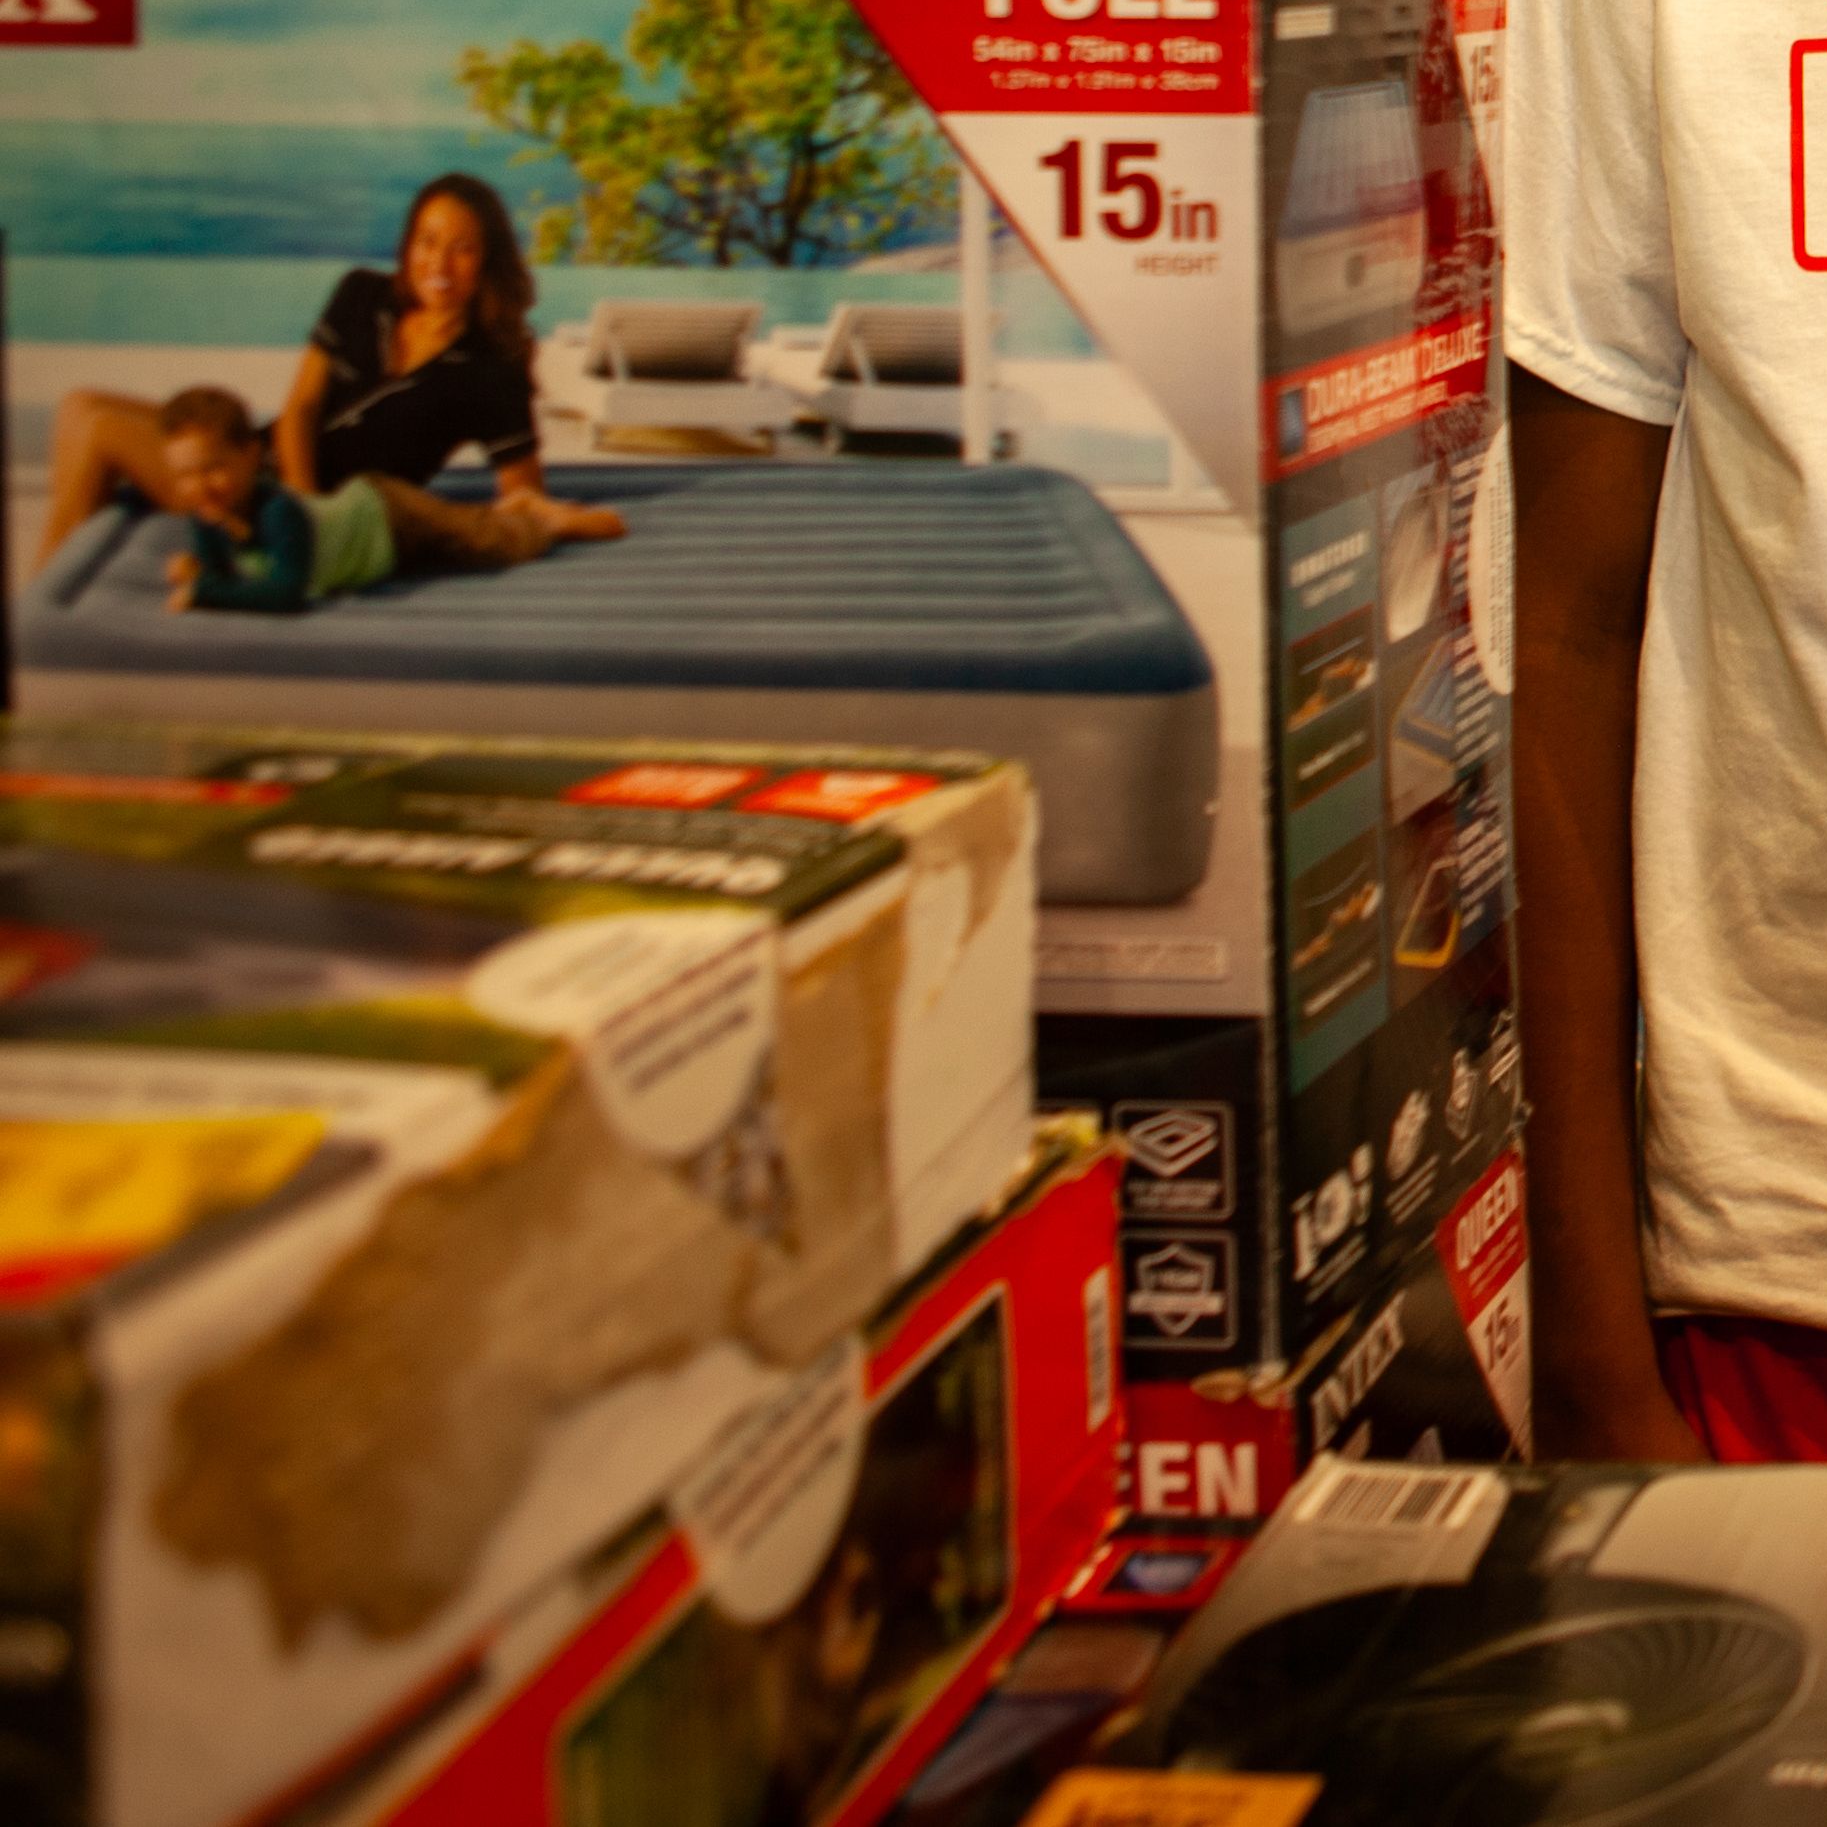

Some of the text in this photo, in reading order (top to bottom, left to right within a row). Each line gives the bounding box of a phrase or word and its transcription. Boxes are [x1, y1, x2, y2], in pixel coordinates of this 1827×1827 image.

[971, 35, 1036, 63] 54in
[1065, 35, 1131, 63] 75in
[1159, 36, 1222, 63] 15in
[1114, 1441, 1259, 1517] EN
